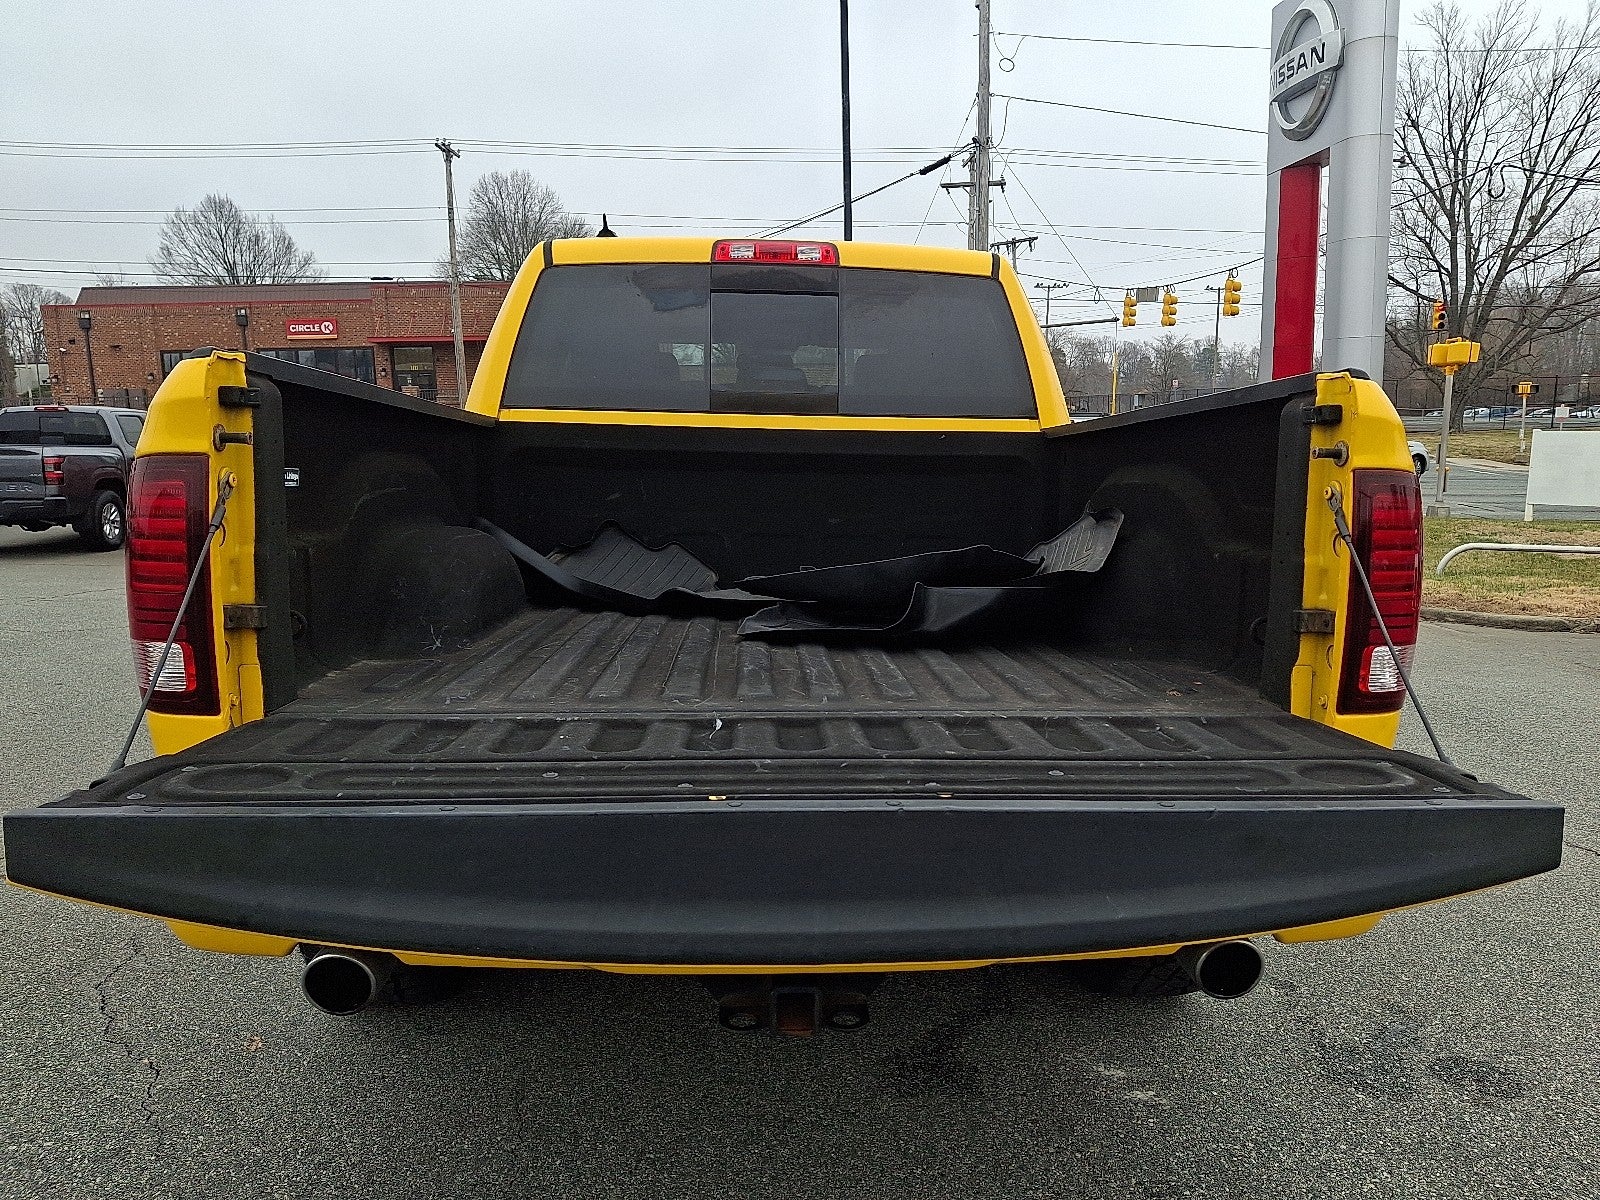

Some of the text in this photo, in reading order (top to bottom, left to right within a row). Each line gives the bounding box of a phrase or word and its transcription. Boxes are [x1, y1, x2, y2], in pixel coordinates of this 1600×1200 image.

[1270, 41, 1326, 91] NISSAN
[289, 322, 333, 333] CIRCLE K
